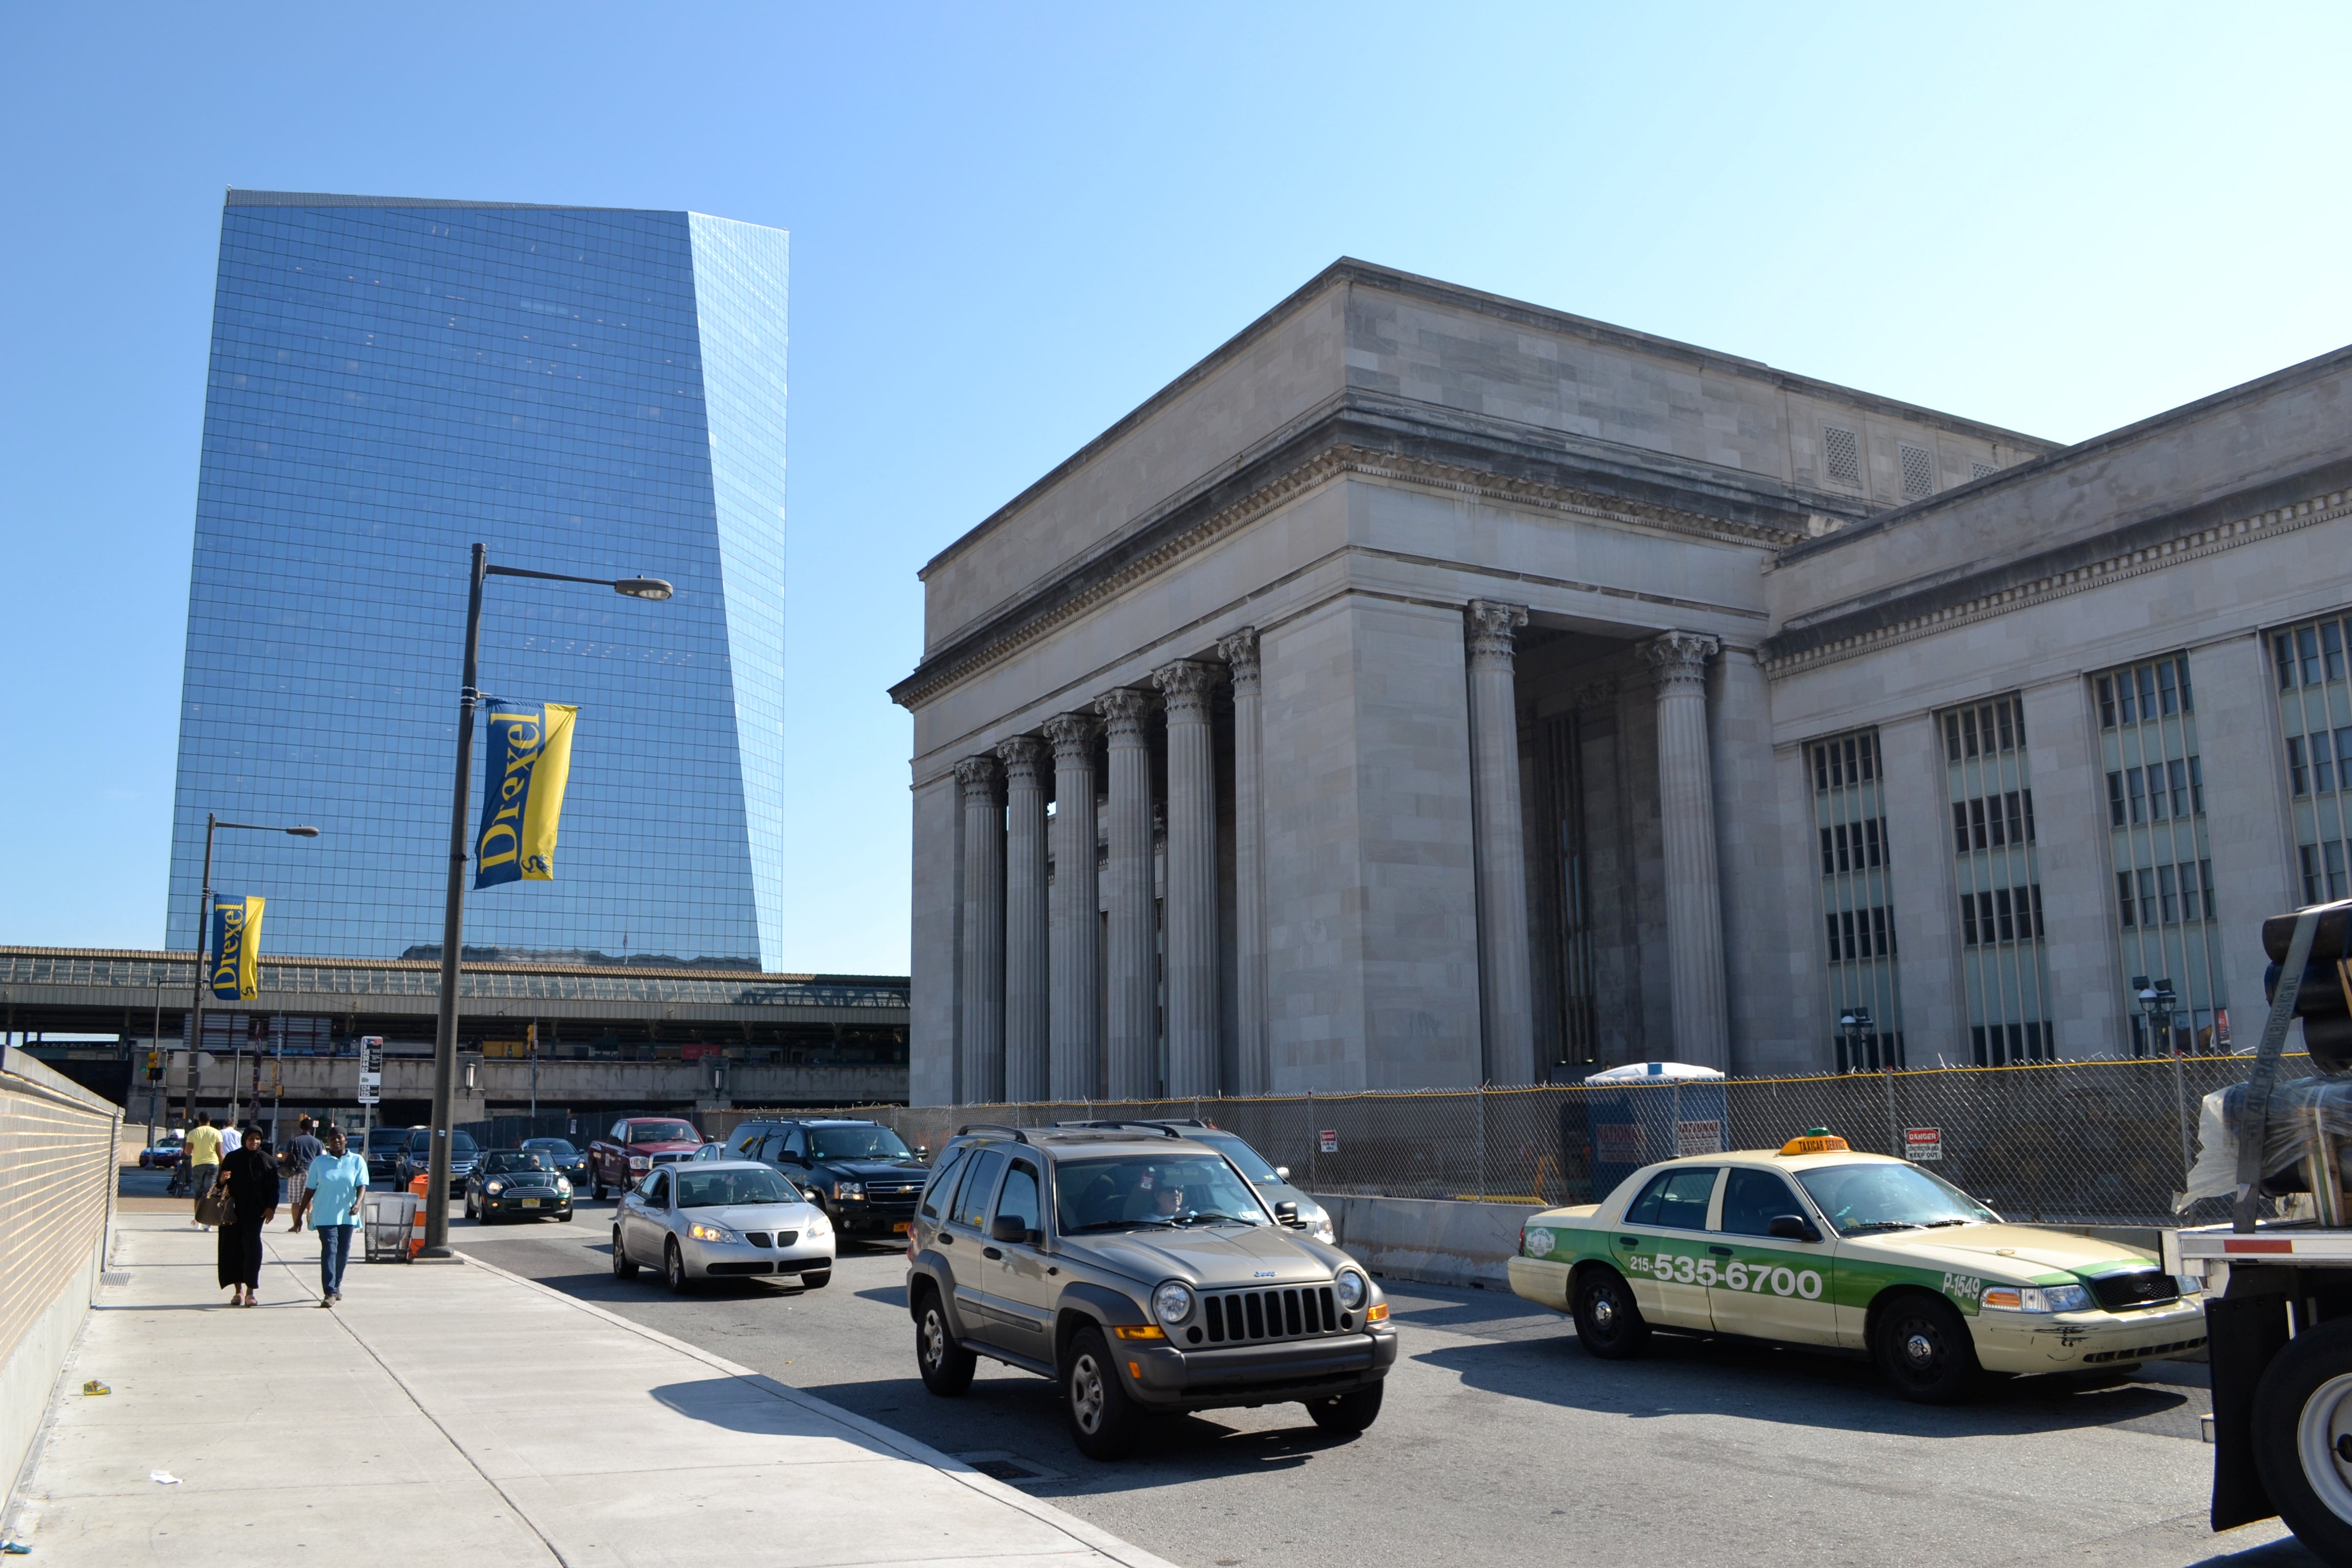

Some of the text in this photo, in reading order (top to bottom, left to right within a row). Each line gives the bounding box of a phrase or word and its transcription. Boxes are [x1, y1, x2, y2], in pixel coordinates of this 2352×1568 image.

[480, 713, 540, 874] Drexel
[213, 903, 243, 991] Drexel
[1798, 1140, 1824, 1152] TAXICAB
[1942, 1272, 1980, 1300] P-1549
